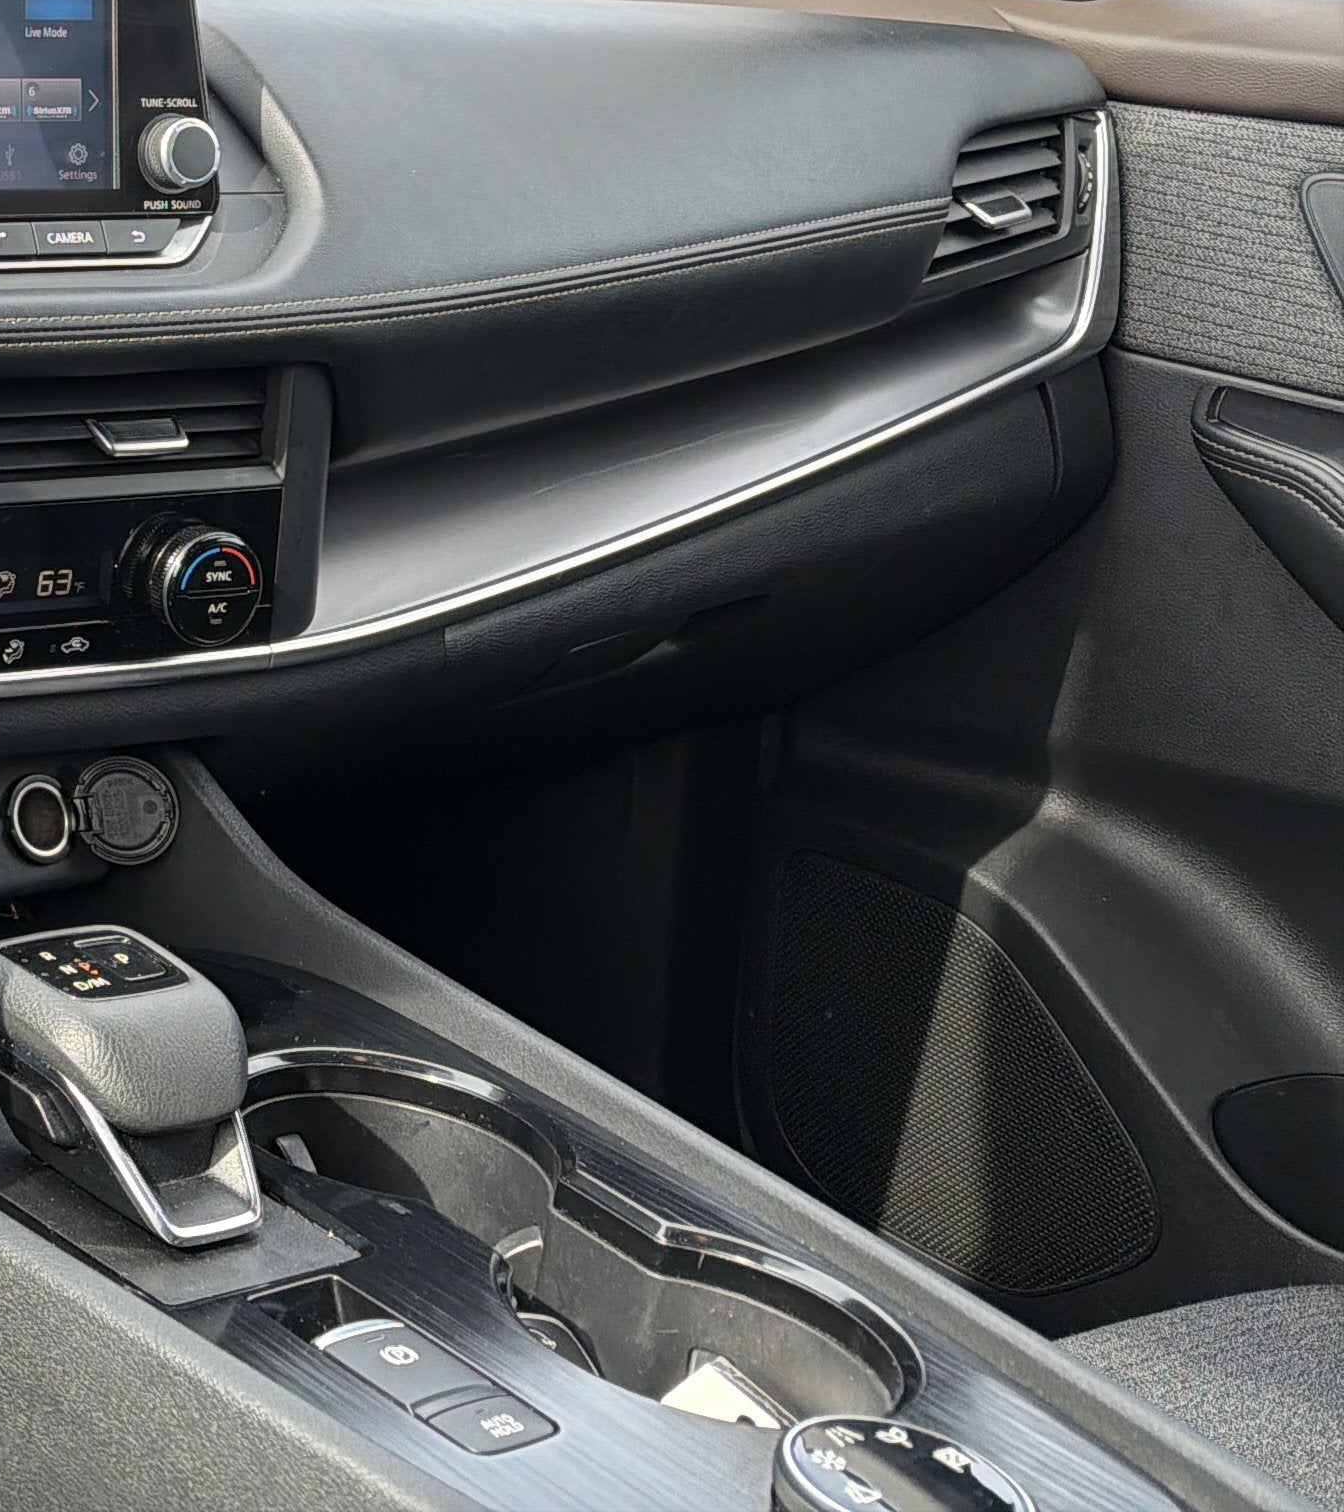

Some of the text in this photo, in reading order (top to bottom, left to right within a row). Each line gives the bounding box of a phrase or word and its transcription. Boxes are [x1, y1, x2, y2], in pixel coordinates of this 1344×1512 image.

[24, 27, 68, 39] Live Mode
[28, 86, 36, 97] 6
[58, 170, 98, 183] Settings
[143, 199, 201, 209] PUSH SOUND
[46, 231, 94, 246] CAMERA
[205, 570, 233, 583] SYNC
[207, 602, 228, 614] A/C
[38, 951, 57, 961] R
[113, 952, 130, 965] P
[58, 963, 79, 976] N
[72, 976, 112, 991] D/M
[480, 1413, 515, 1431] AUTO
[489, 1422, 525, 1439] HOLD
